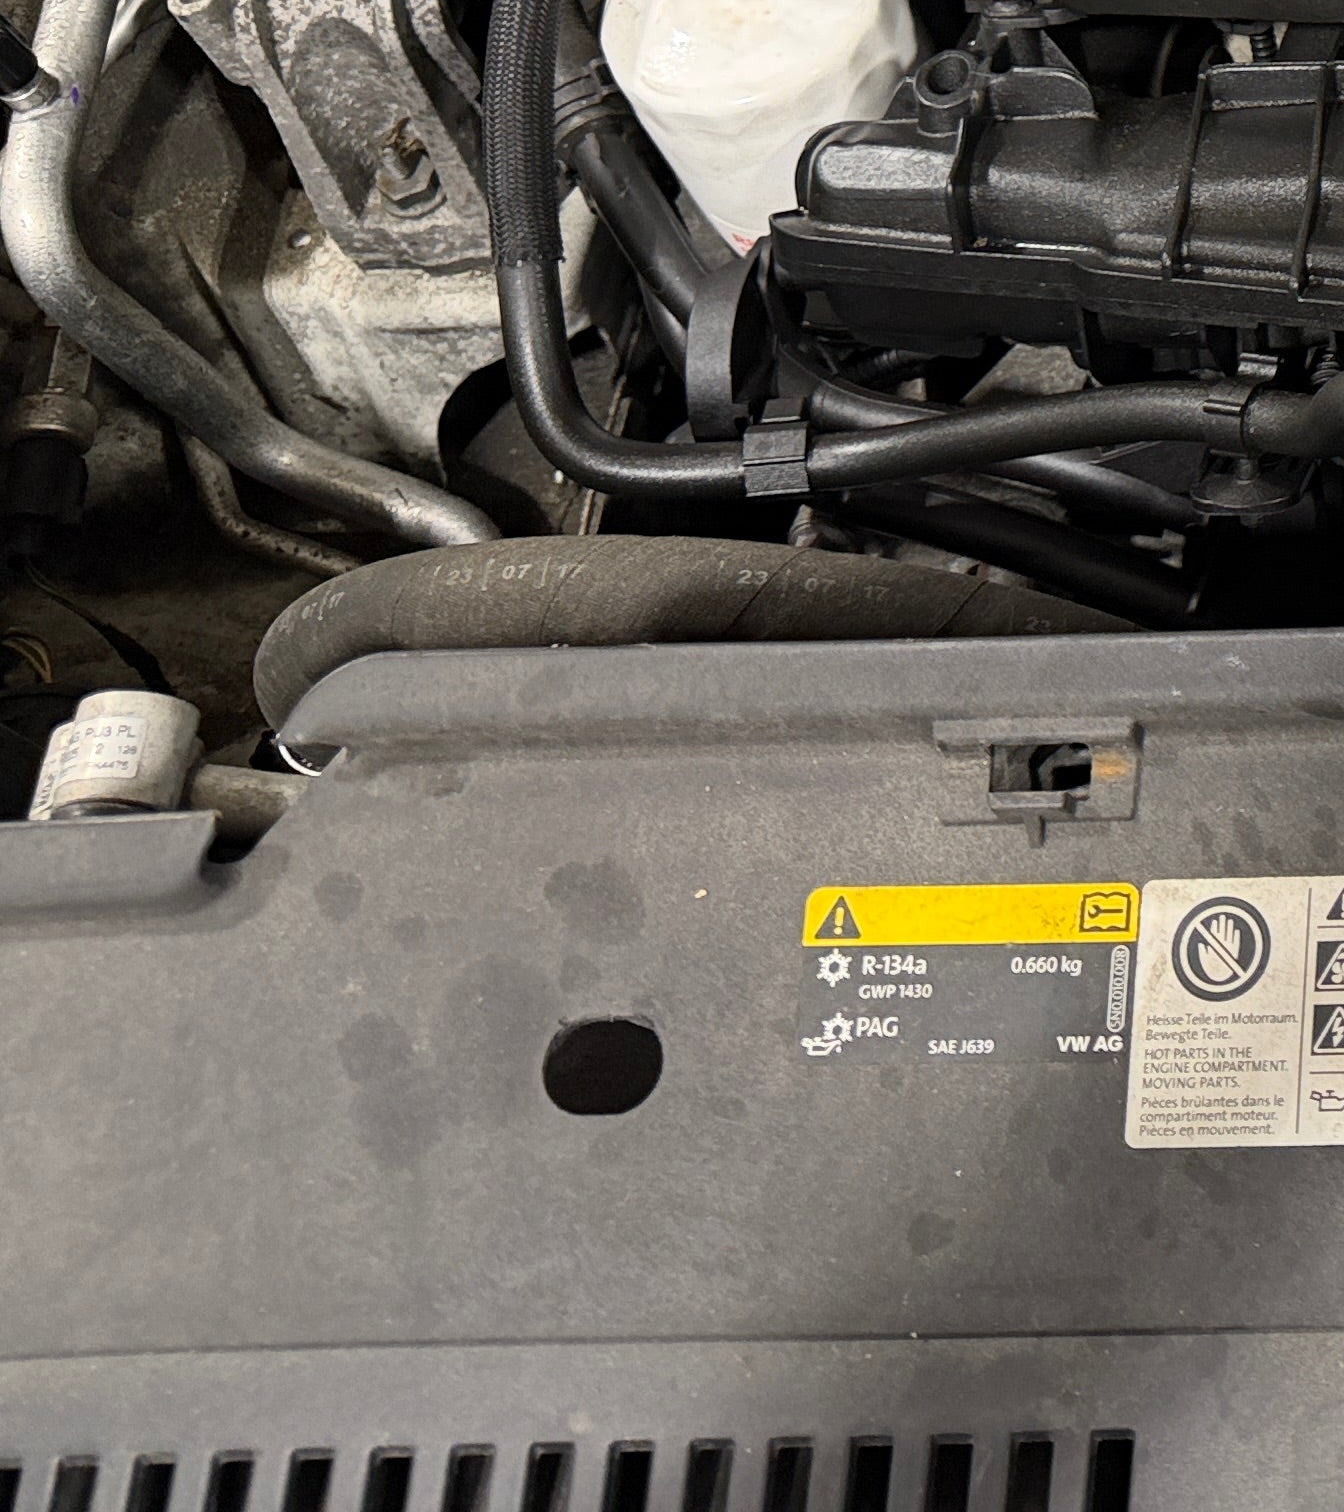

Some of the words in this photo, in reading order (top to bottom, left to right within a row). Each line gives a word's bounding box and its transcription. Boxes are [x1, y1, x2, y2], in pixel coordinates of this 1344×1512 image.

[450, 570, 472, 586] 23
[502, 563, 533, 580] 07
[736, 570, 768, 585] 23
[862, 956, 927, 976] R-134a
[1011, 957, 1058, 974] 0.660
[1061, 957, 1082, 977] kg
[858, 984, 897, 999] GWP
[899, 984, 933, 999] 1430
[856, 1016, 898, 1038] PAG
[928, 1040, 956, 1056] SAE
[959, 1039, 994, 1055] J639
[1057, 1036, 1092, 1053] VW
[1094, 1036, 1124, 1052] AG
[1145, 1048, 1170, 1060] HOT
[1174, 1047, 1208, 1059] PARTS
[1213, 1048, 1226, 1058] IN
[1229, 1047, 1252, 1058] THE
[1143, 1062, 1190, 1074] ENGINE
[1142, 1077, 1196, 1089] MOVING
